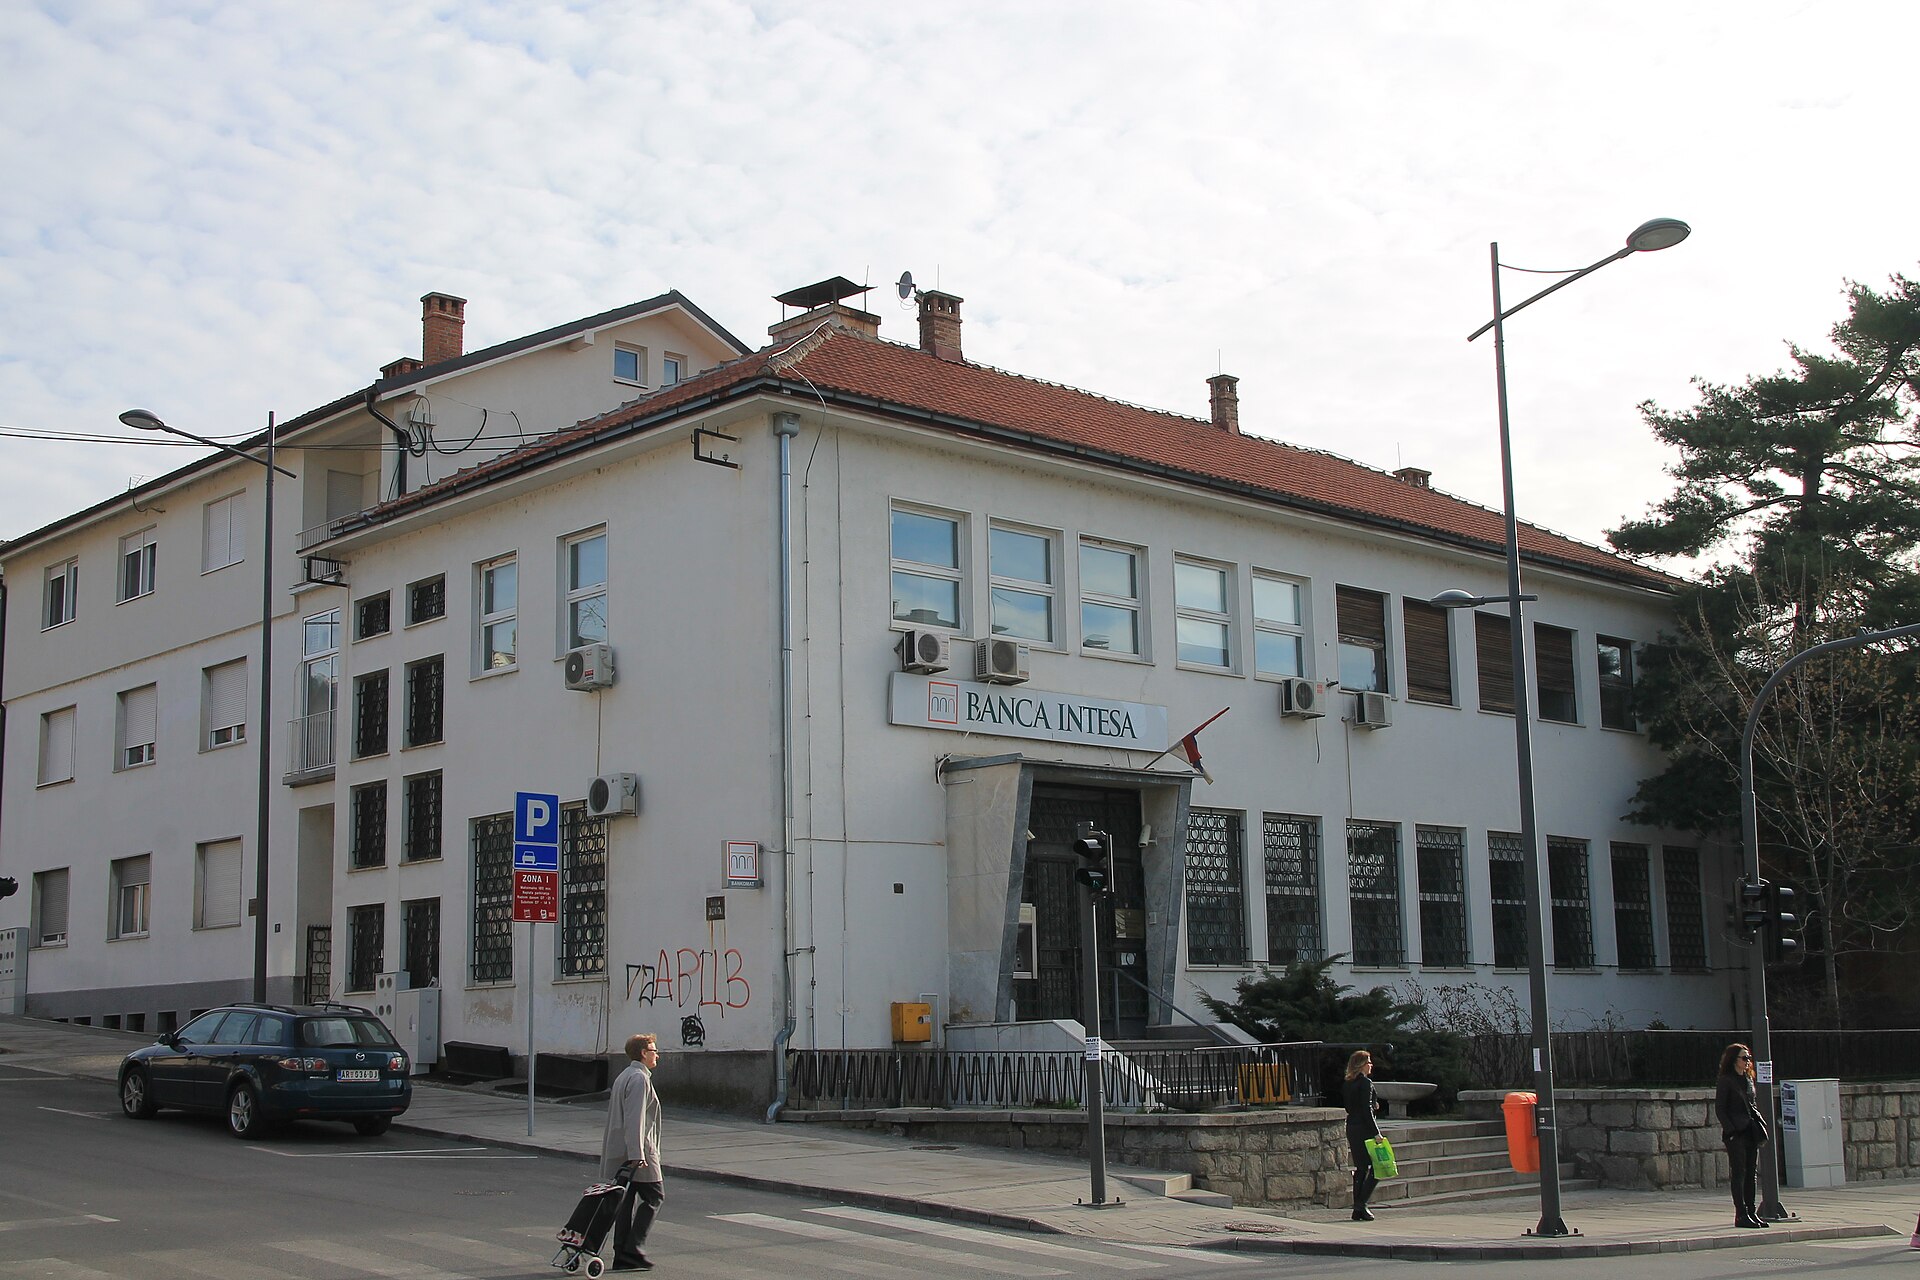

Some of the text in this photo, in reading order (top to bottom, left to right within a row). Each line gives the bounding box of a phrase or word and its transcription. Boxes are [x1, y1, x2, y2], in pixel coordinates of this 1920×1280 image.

[966, 691, 1138, 739] BANCA INTESA
[526, 799, 550, 837] P
[522, 874, 542, 883] ZONA
